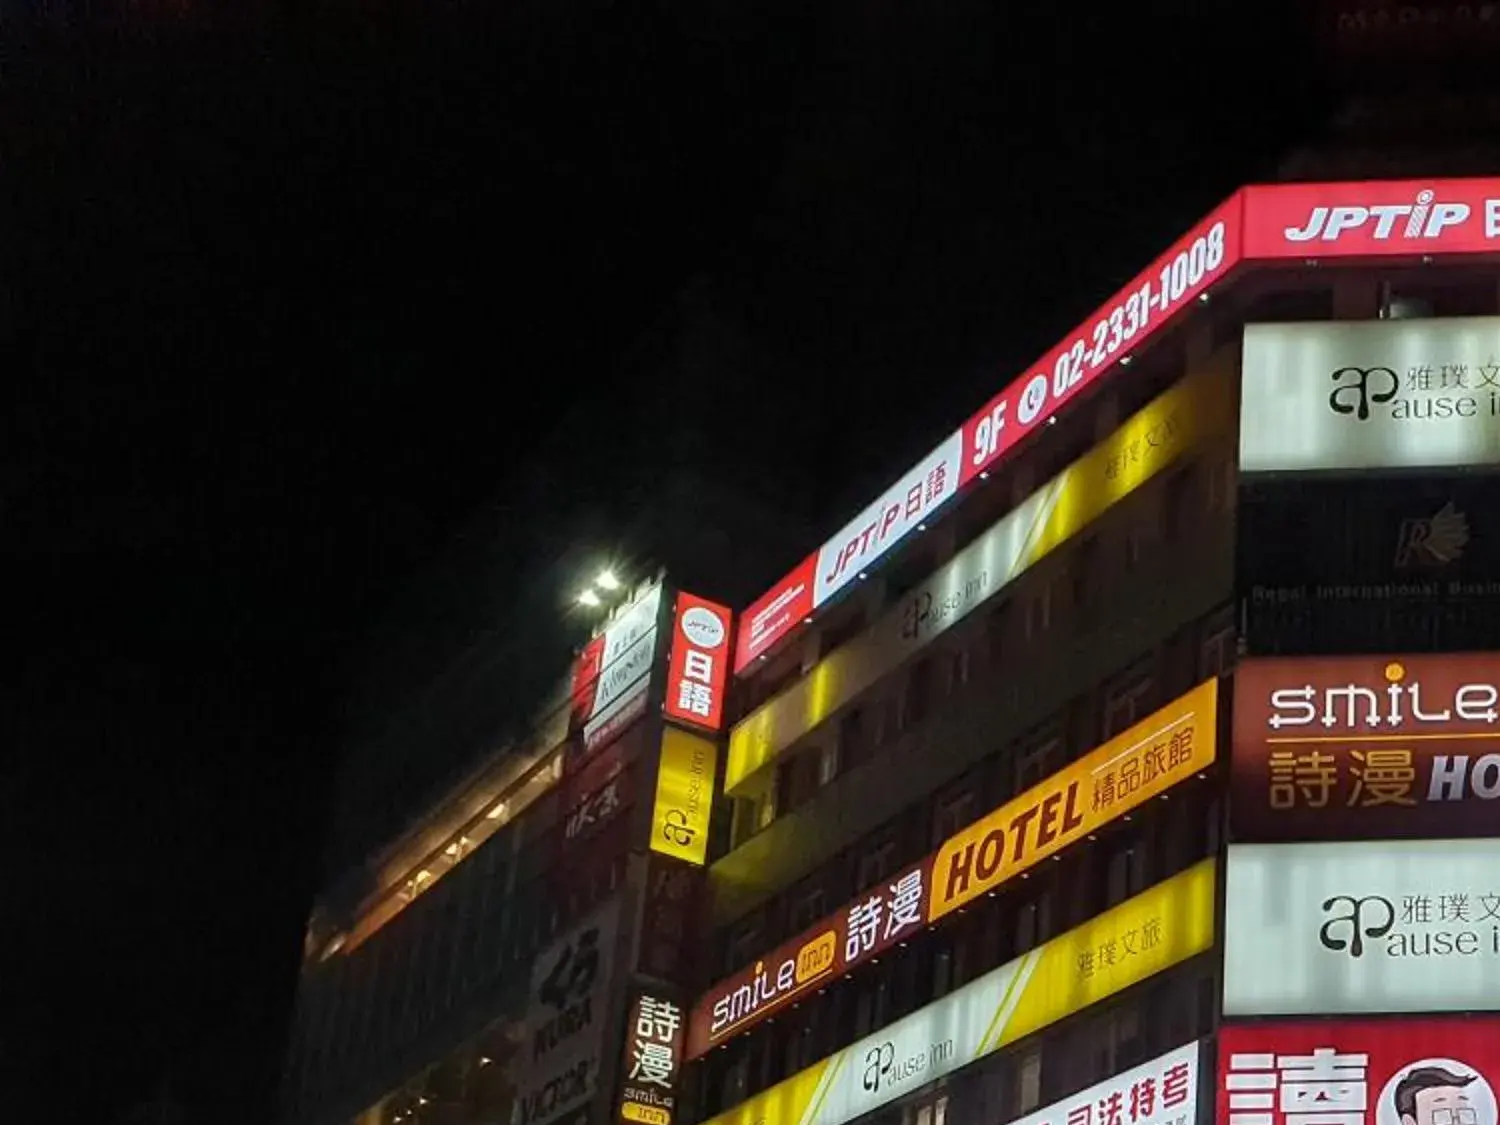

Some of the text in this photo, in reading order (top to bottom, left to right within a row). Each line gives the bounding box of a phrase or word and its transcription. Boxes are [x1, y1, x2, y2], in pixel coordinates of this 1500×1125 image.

[973, 222, 1225, 466] 9F 02-2331-1008
[904, 460, 948, 521] 日語
[678, 650, 713, 717] 日語
[1268, 661, 1499, 729] smile
[1091, 725, 1195, 813] 精品旅館
[1267, 748, 1418, 811] 詩漫
[944, 781, 1084, 902] HOTEL
[845, 868, 922, 963] 詩漫
[710, 960, 796, 1033] smile
[629, 996, 681, 1088] 詩漫
